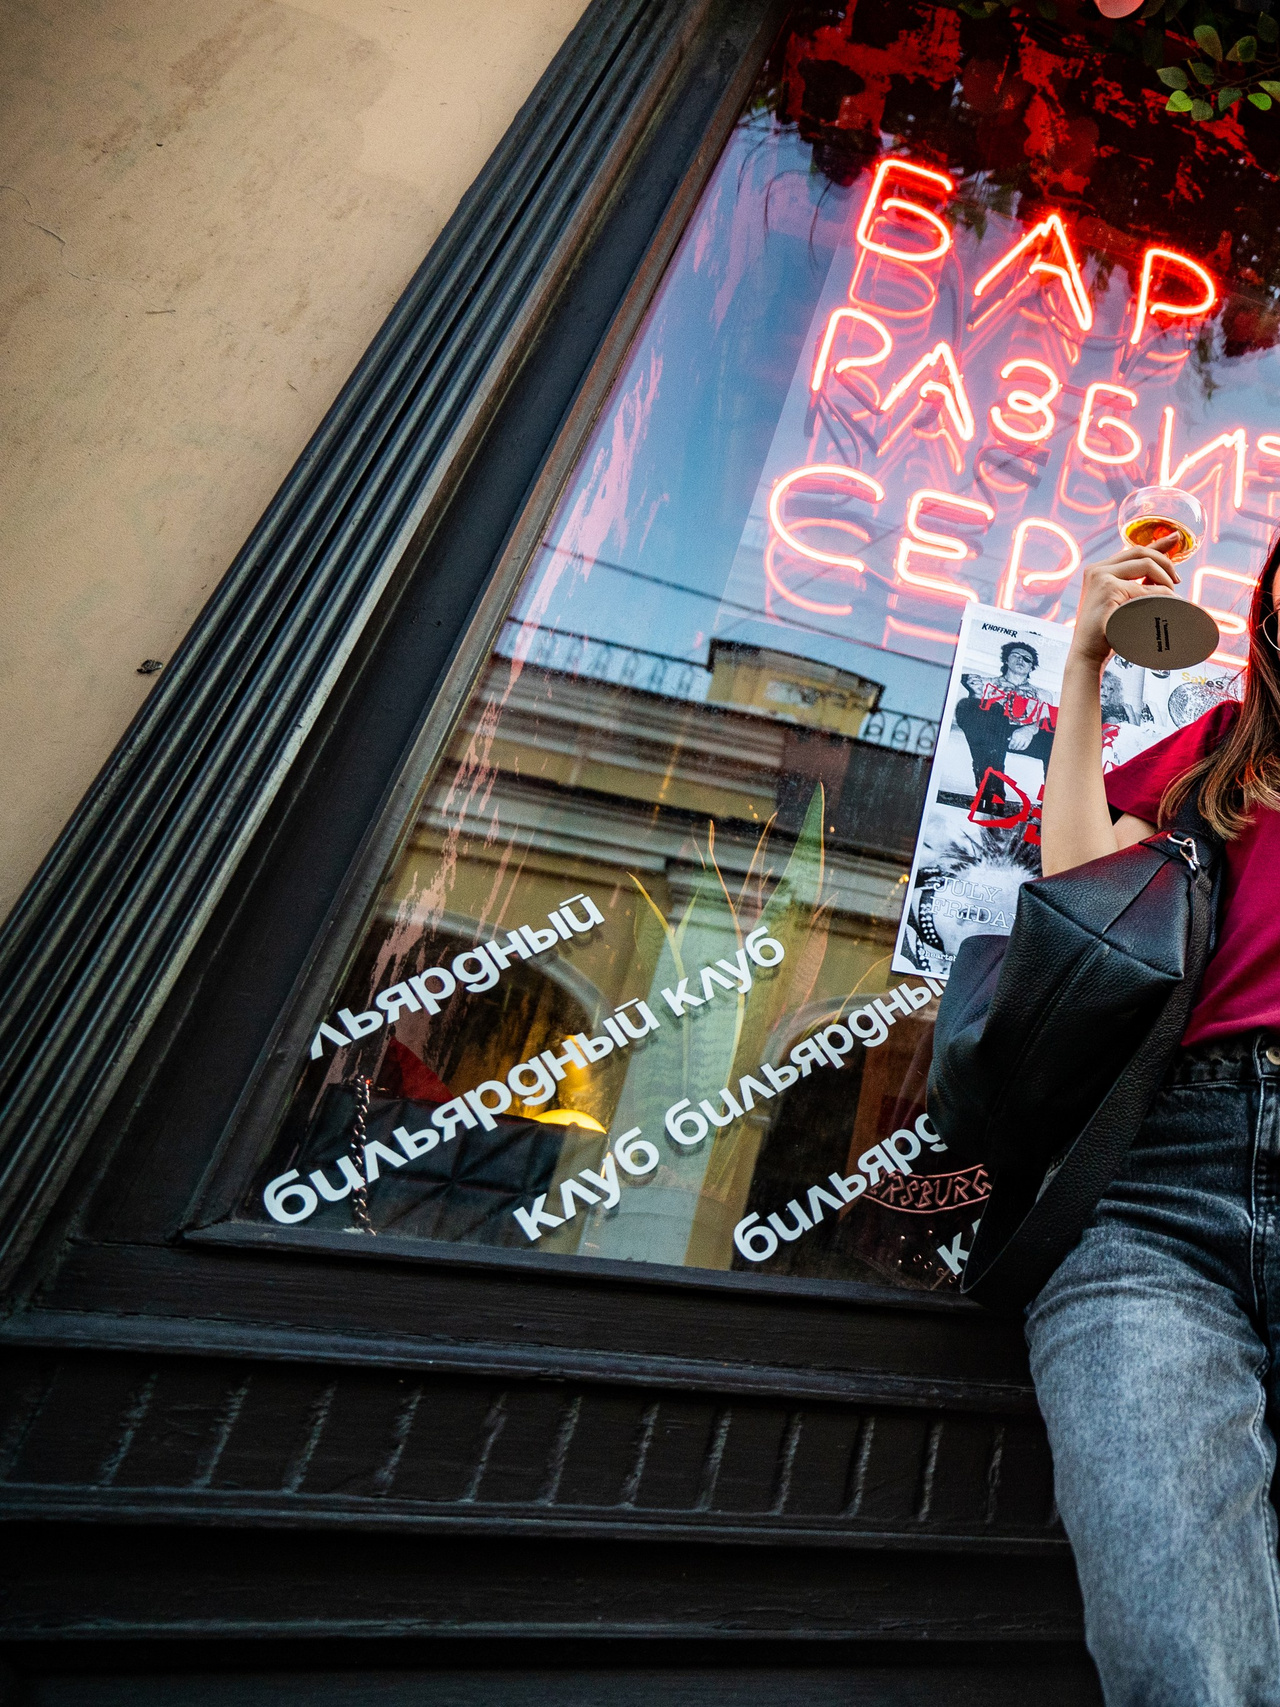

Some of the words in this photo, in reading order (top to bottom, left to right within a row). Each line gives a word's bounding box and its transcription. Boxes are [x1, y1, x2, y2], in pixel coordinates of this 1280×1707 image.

[856, 158, 1219, 344] БАР
[981, 622, 1018, 638] KHOFFNER
[933, 876, 1002, 903] JULY
[263, 997, 661, 1226] бильярдный
[660, 926, 785, 1017] клуб
[513, 1126, 661, 1242] клуб
[665, 977, 947, 1146] бильярдны
